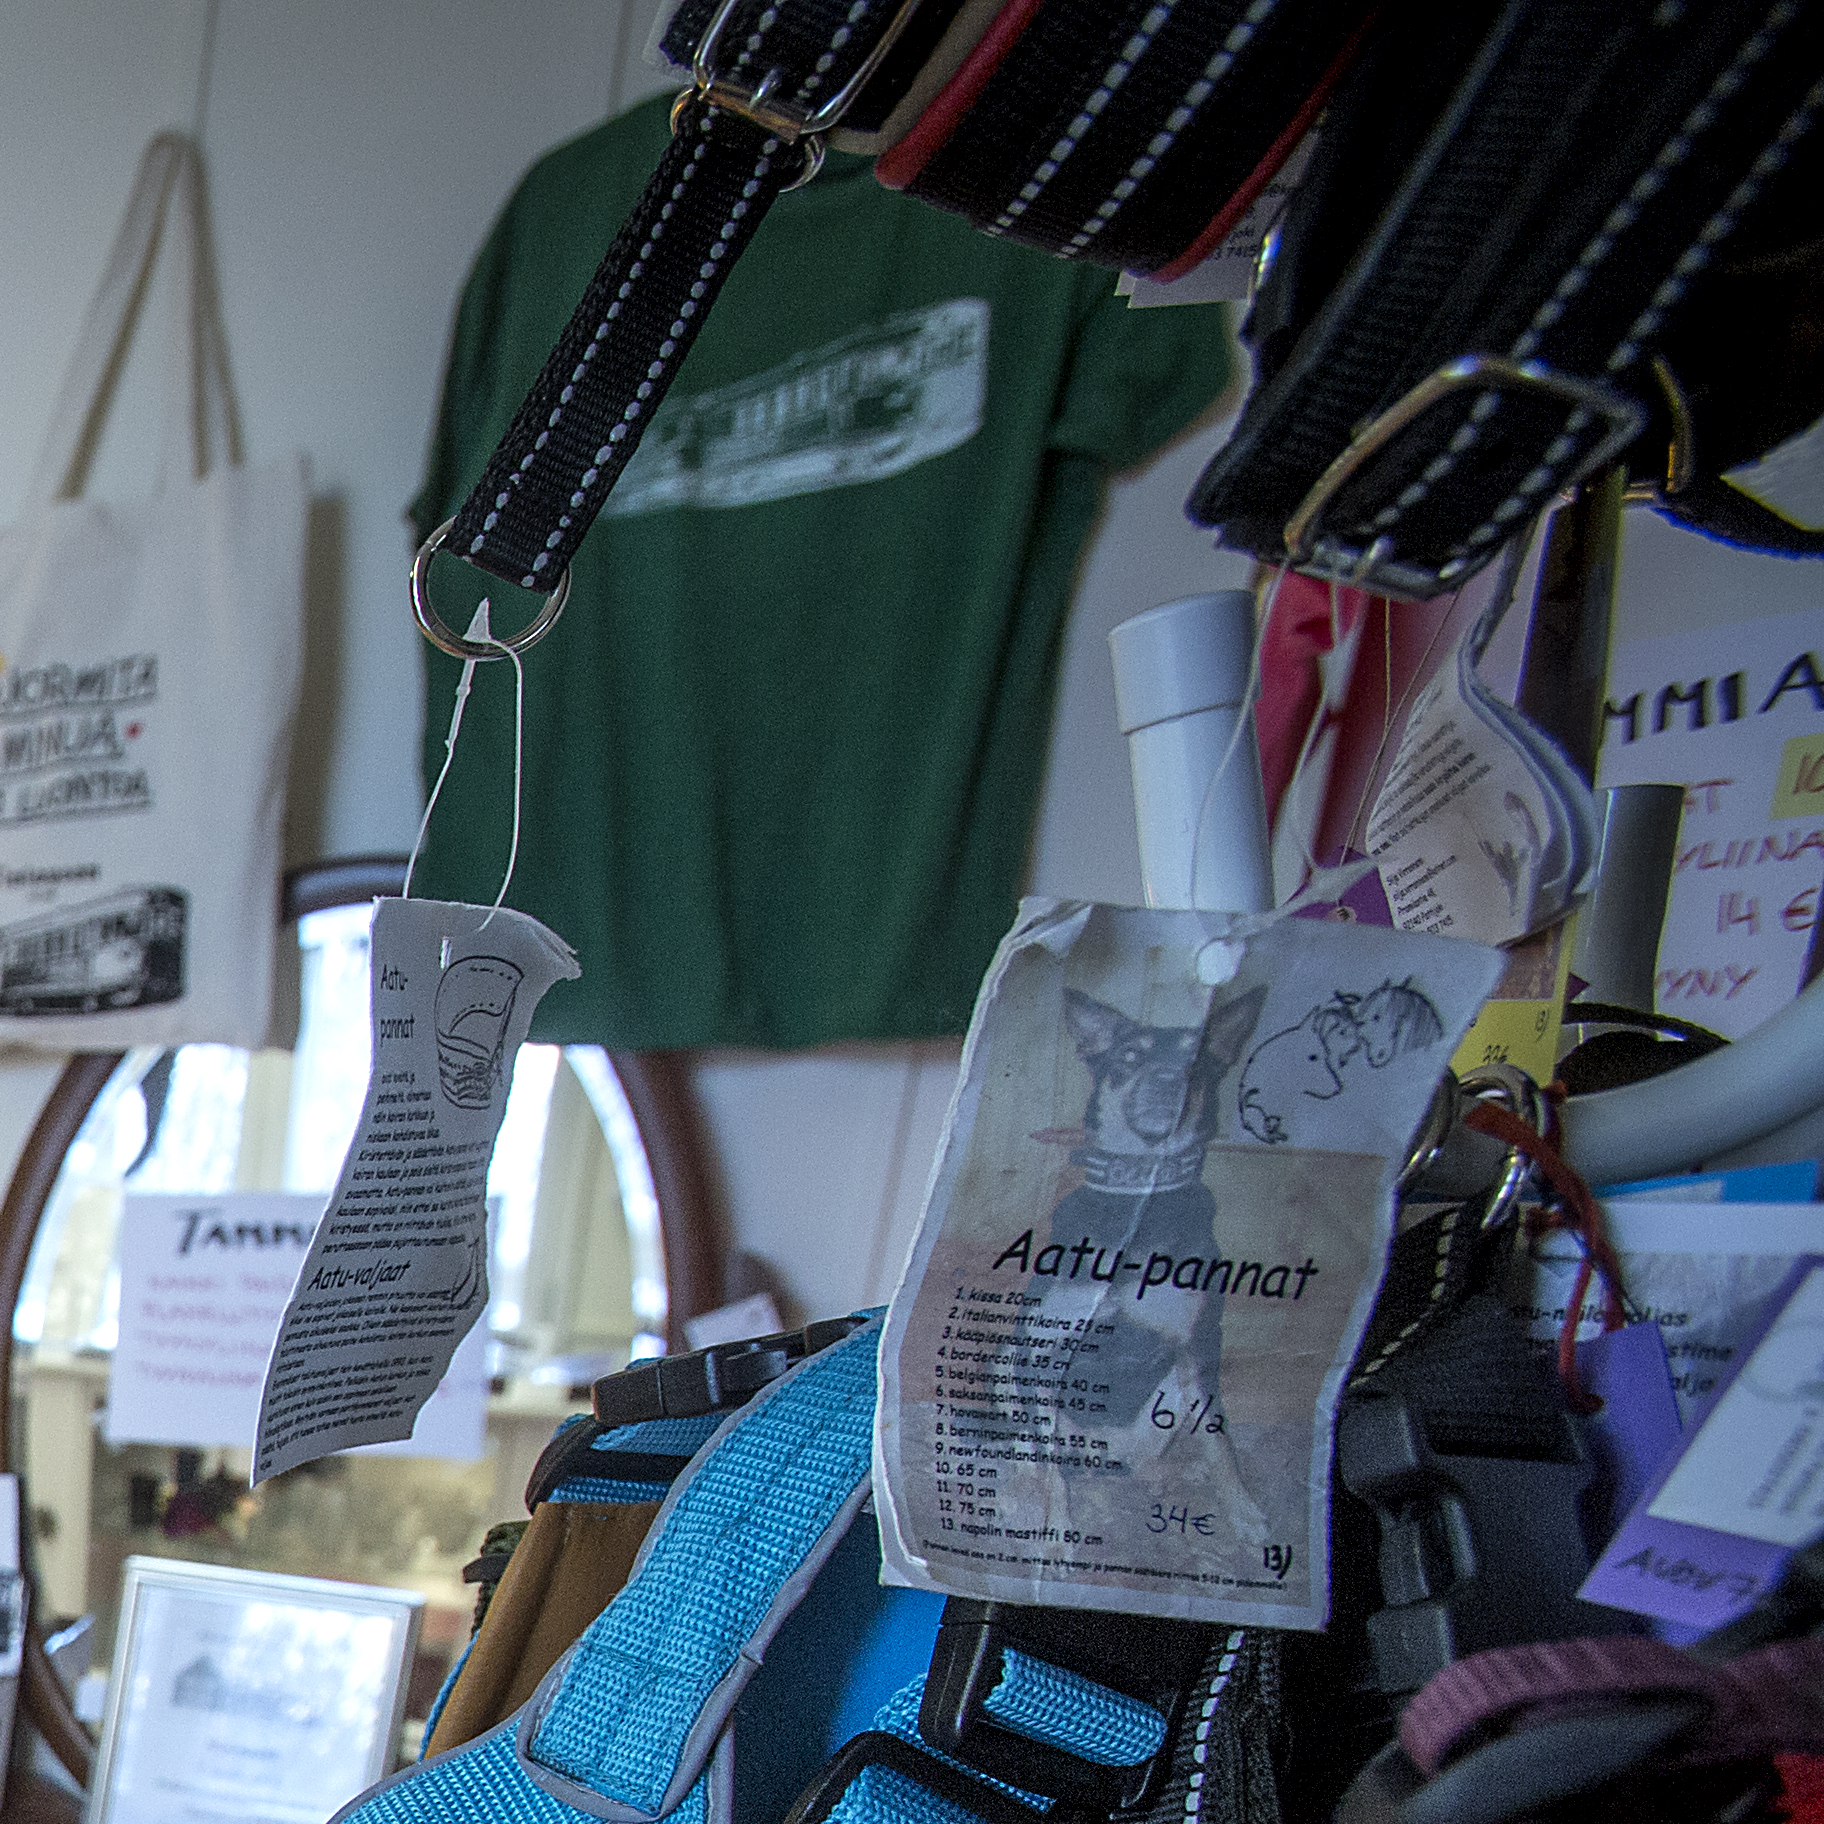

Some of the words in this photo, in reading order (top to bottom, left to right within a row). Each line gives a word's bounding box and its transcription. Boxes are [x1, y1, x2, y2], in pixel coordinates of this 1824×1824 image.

[1717, 892, 1760, 937] 14
[380, 1015, 415, 1047] pannat
[173, 1206, 314, 1257] TAMM
[991, 1228, 1320, 1301] Aatu-pannat
[307, 1260, 411, 1290] Aatu-valjaat
[969, 1288, 1003, 1304] kissa
[1095, 1324, 1115, 1335] cm
[1080, 1342, 1100, 1354] cm
[950, 1346, 1028, 1368] bordercollie
[1031, 1354, 1051, 1369] 35
[1052, 1361, 1071, 1373] cm
[1071, 1379, 1088, 1393] 40
[1091, 1383, 1111, 1395] cm
[950, 1405, 1008, 1423] hovawart
[1012, 1410, 1029, 1424] 50
[1032, 1414, 1053, 1427] cm
[1068, 1399, 1087, 1412] 45
[1089, 1402, 1108, 1414] cm
[1151, 1391, 1176, 1430] 6
[1070, 1434, 1086, 1448] 55
[1090, 1438, 1109, 1450] cm
[935, 1461, 952, 1475] 10.
[956, 1463, 974, 1477] 65
[978, 1467, 997, 1479] cm
[1084, 1455, 1101, 1468] 60
[1105, 1458, 1123, 1471] cm
[957, 1483, 974, 1497] 70
[978, 1487, 997, 1499] cm
[959, 1501, 975, 1516] 75
[978, 1507, 997, 1518] cm
[1145, 1502, 1217, 1537] 34€
[960, 1523, 1002, 1539] napolin
[1005, 1528, 1059, 1542] mastiffi
[1063, 1529, 1081, 1544] 80
[1084, 1534, 1103, 1546] cm
